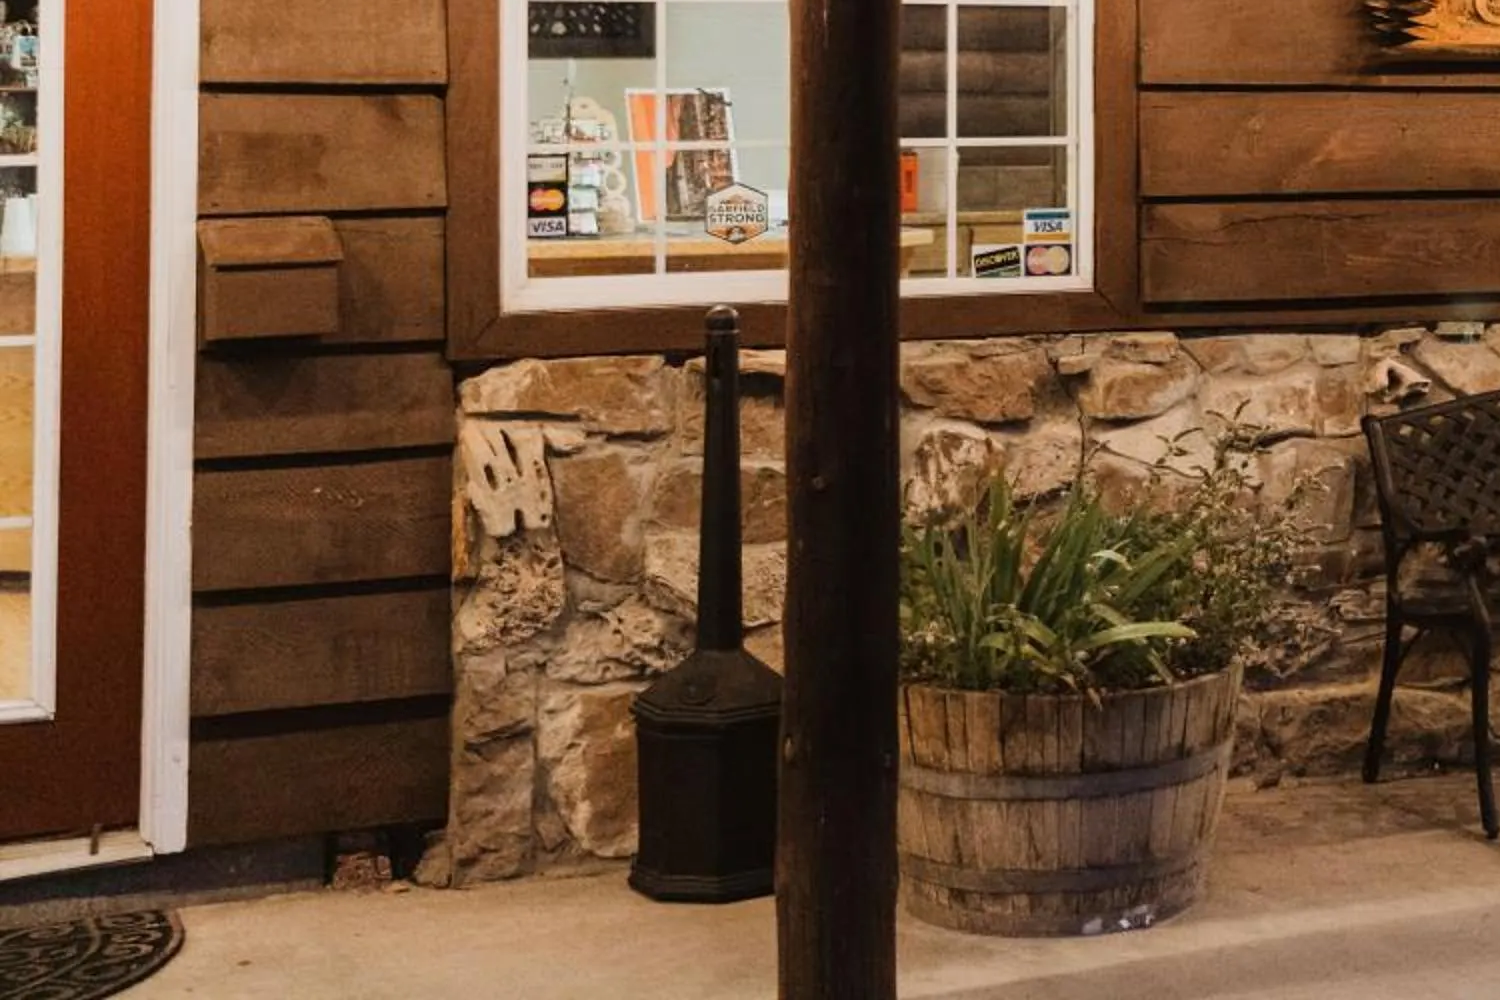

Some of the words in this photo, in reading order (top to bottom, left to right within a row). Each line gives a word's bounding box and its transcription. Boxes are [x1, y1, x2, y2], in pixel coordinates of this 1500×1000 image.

[708, 212, 766, 224] STRONG
[532, 221, 565, 233] VISA
[1033, 221, 1064, 233] VISA
